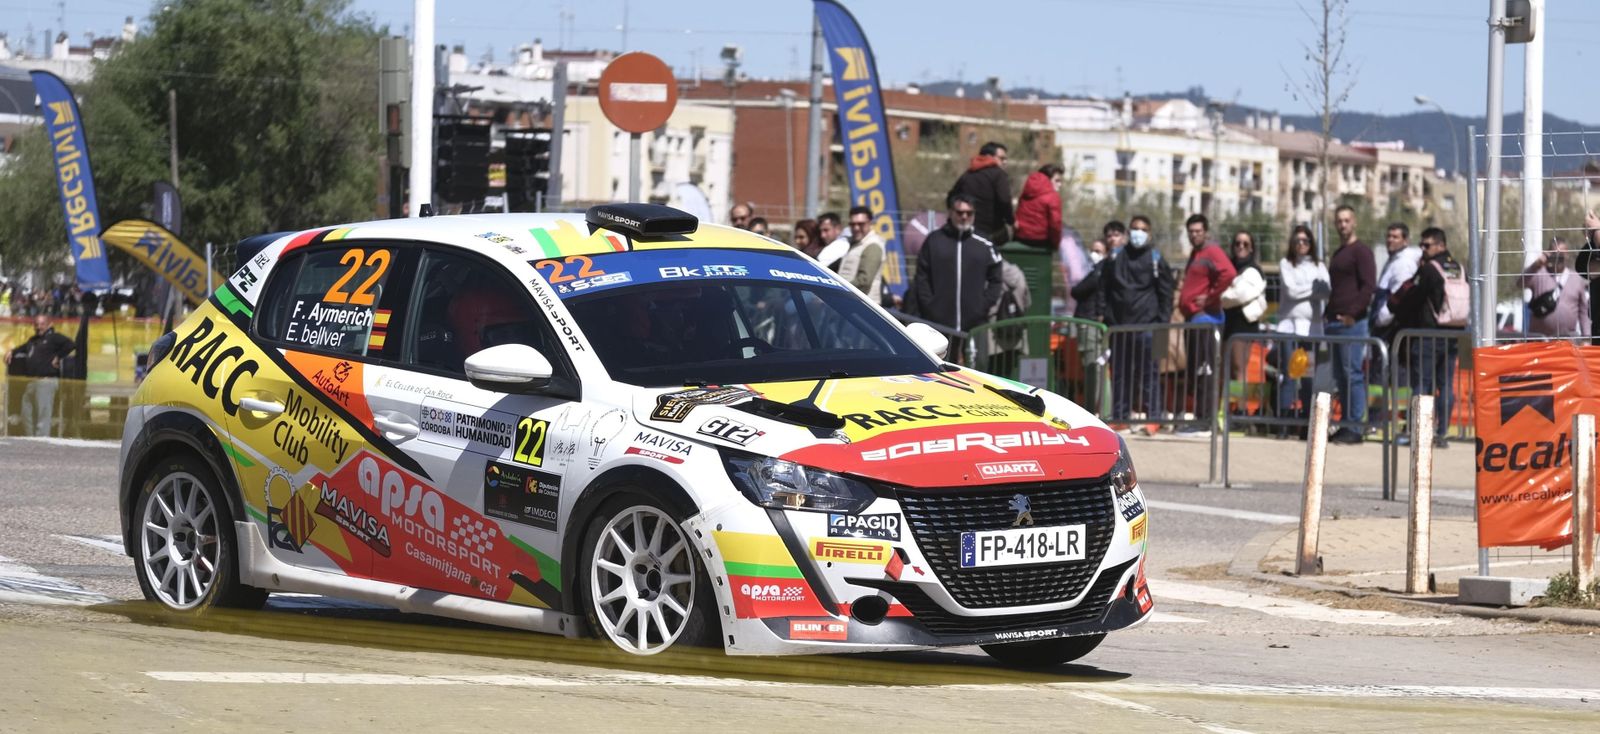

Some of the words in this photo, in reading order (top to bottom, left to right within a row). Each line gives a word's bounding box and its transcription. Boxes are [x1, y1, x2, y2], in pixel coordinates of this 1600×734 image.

[323, 248, 391, 306] 22
[535, 255, 605, 284] 22
[292, 300, 306, 320] F.
[308, 302, 373, 326] Aymerich
[286, 322, 298, 341] E.
[301, 323, 346, 347] bellver
[170, 316, 259, 417] RACC
[312, 370, 349, 406] AutoArt
[284, 388, 349, 464] Mobility
[456, 412, 506, 433] PATRIMONIO
[842, 404, 962, 431] RACC
[273, 420, 309, 466] Club
[455, 424, 511, 449] HUMANIDAD
[513, 417, 547, 466] 22
[634, 431, 692, 456] MAVISA
[982, 462, 1039, 476] QUARTZ
[357, 456, 445, 533] apsa
[320, 481, 391, 546] MAVISA
[847, 515, 899, 530] PAGID
[335, 514, 371, 542] SPORT
[830, 527, 899, 539] RACING
[392, 511, 501, 579] MOTORSPORT
[815, 541, 884, 561] PIRELLI
[965, 552, 973, 563] F
[981, 530, 1080, 562] FP-418-LR
[741, 583, 780, 600] apsa
[793, 623, 845, 632] BLINKER
